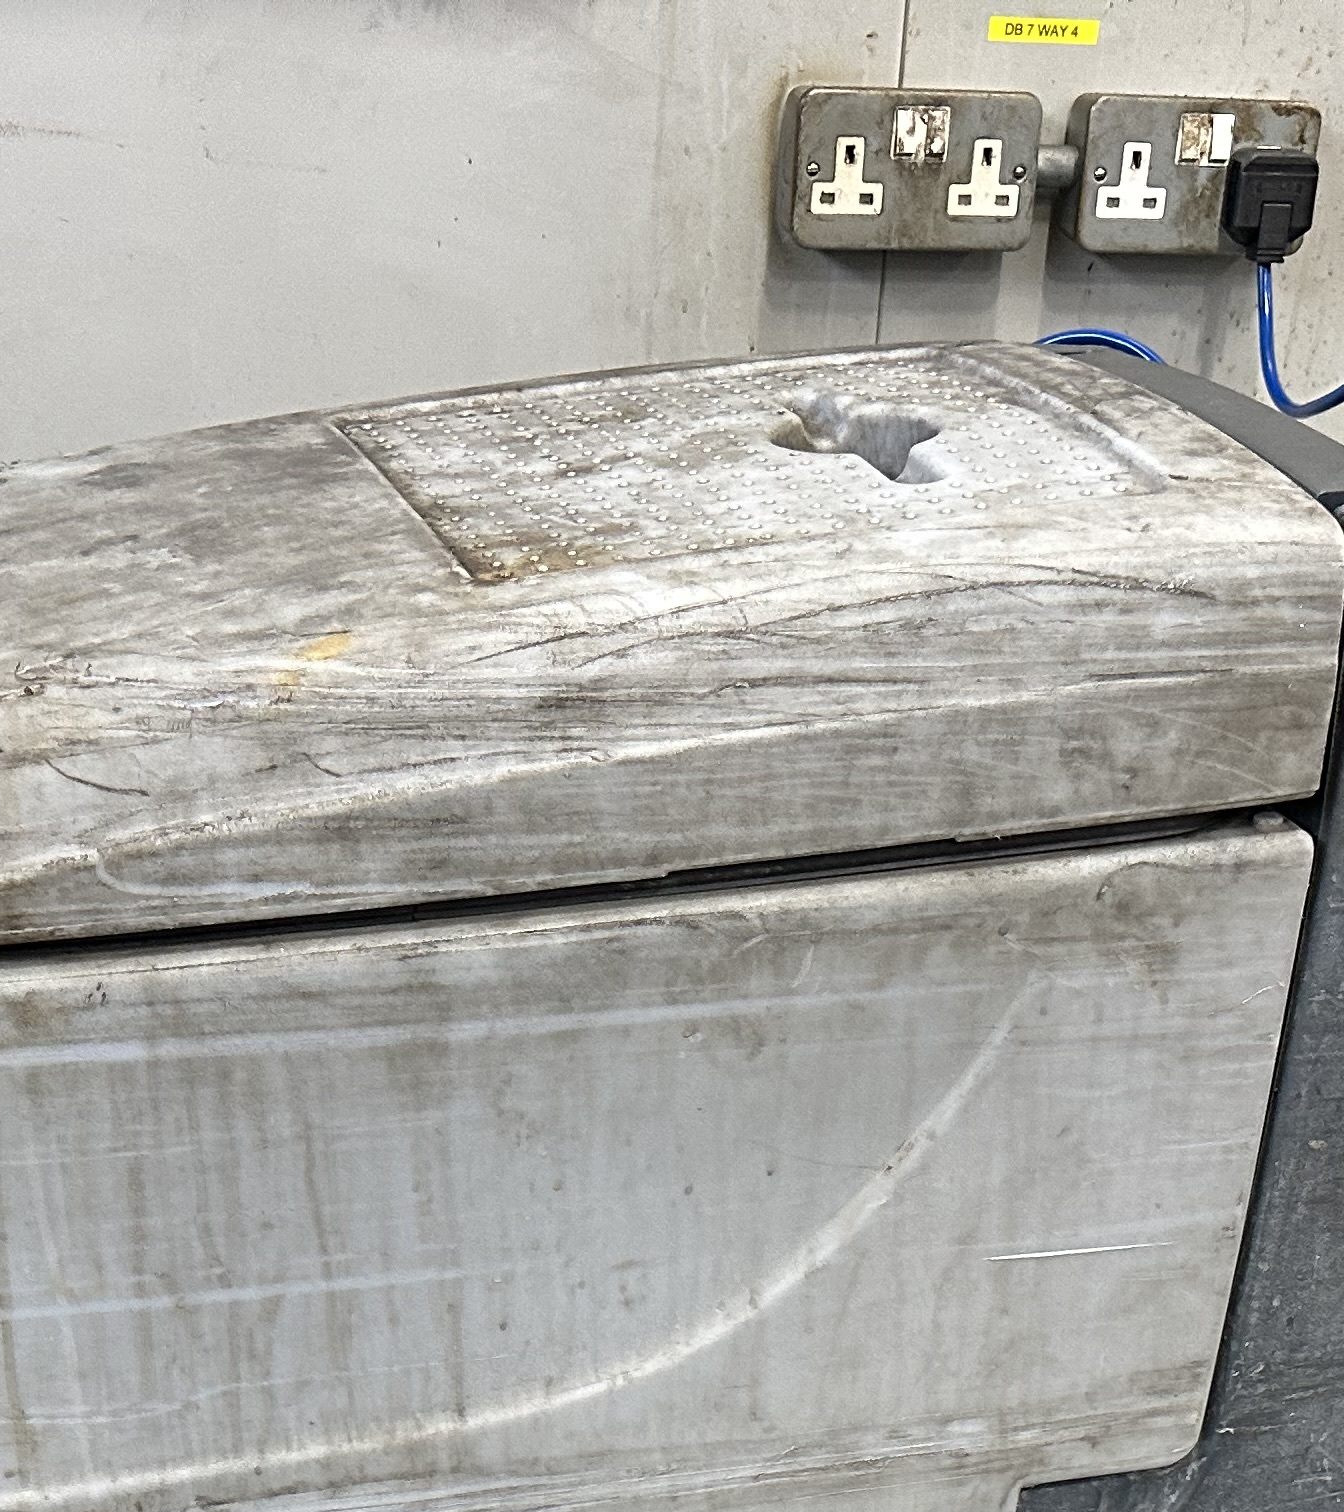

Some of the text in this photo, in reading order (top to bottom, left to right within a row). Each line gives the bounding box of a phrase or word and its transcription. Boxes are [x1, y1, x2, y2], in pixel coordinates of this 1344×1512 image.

[1005, 23, 1078, 37] DB 7 WAY 4
